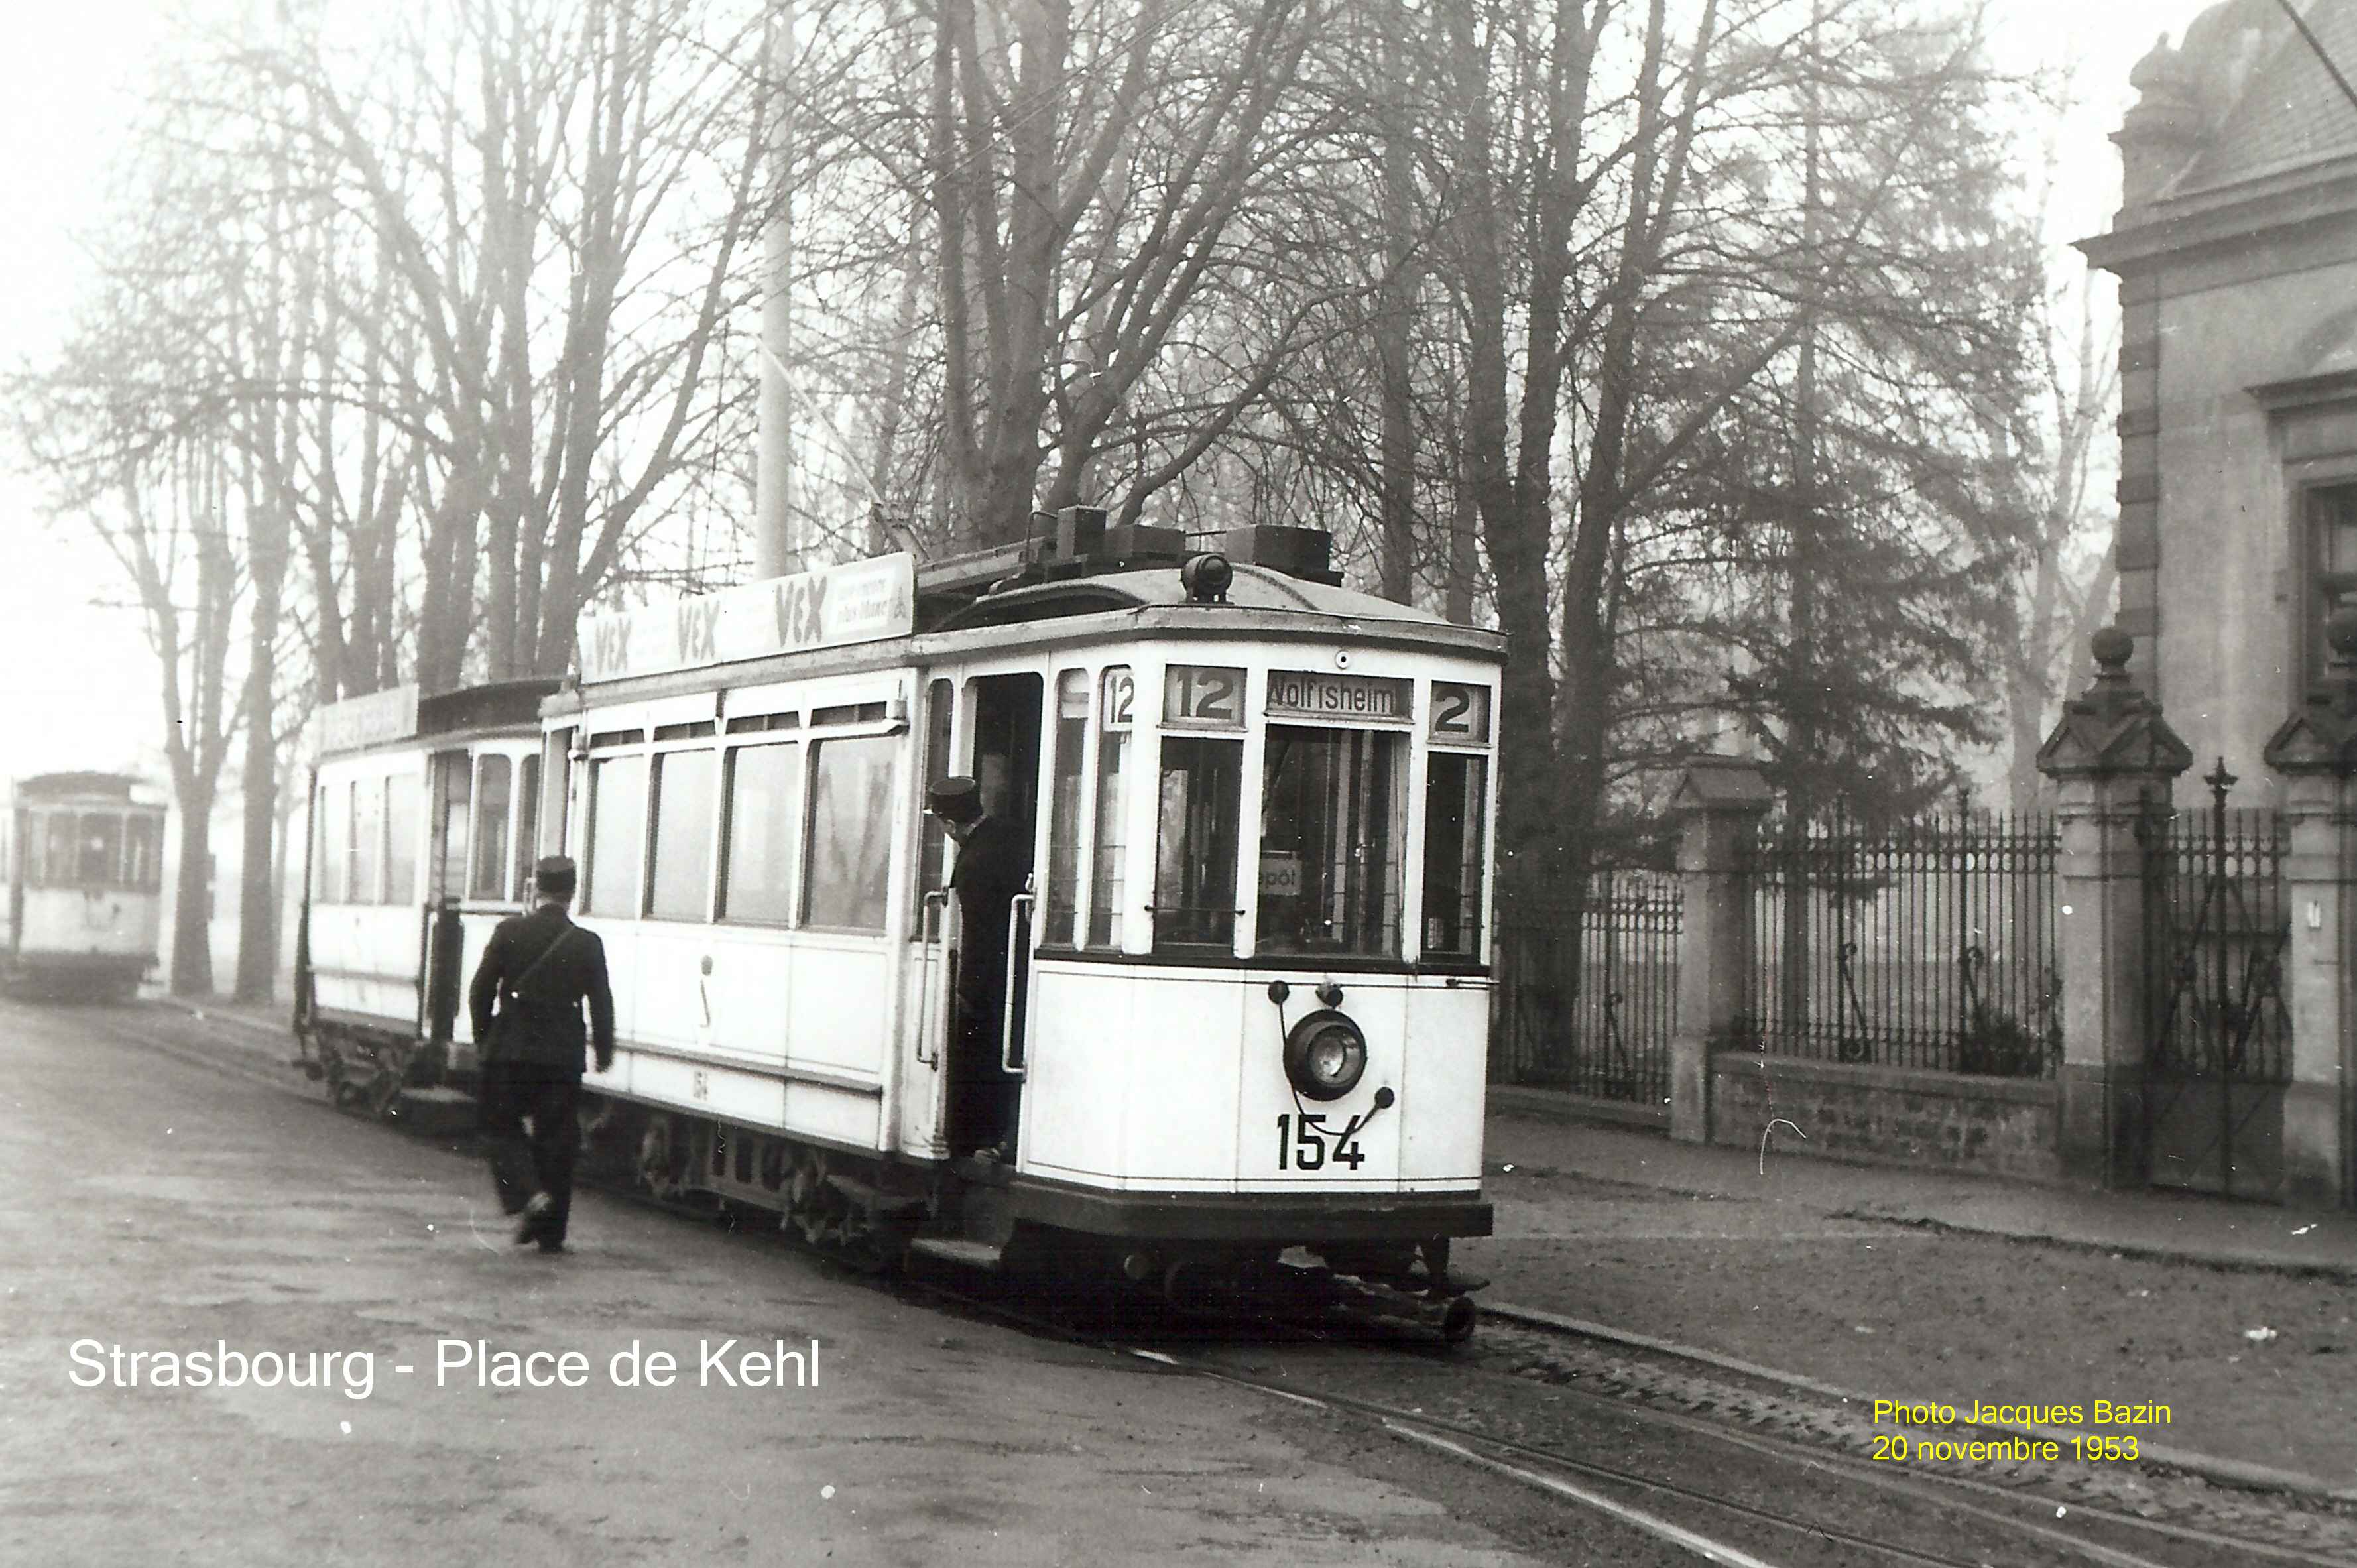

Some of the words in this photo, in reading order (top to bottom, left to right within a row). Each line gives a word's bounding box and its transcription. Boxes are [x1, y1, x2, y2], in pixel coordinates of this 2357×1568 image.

[677, 599, 721, 664] VEX
[774, 575, 828, 648] VEX
[595, 617, 632, 675] VEX
[1110, 676, 1134, 724] 12
[1176, 670, 1233, 719] 12
[1260, 869, 1296, 889] pôt
[1276, 1113, 1365, 1170] 154
